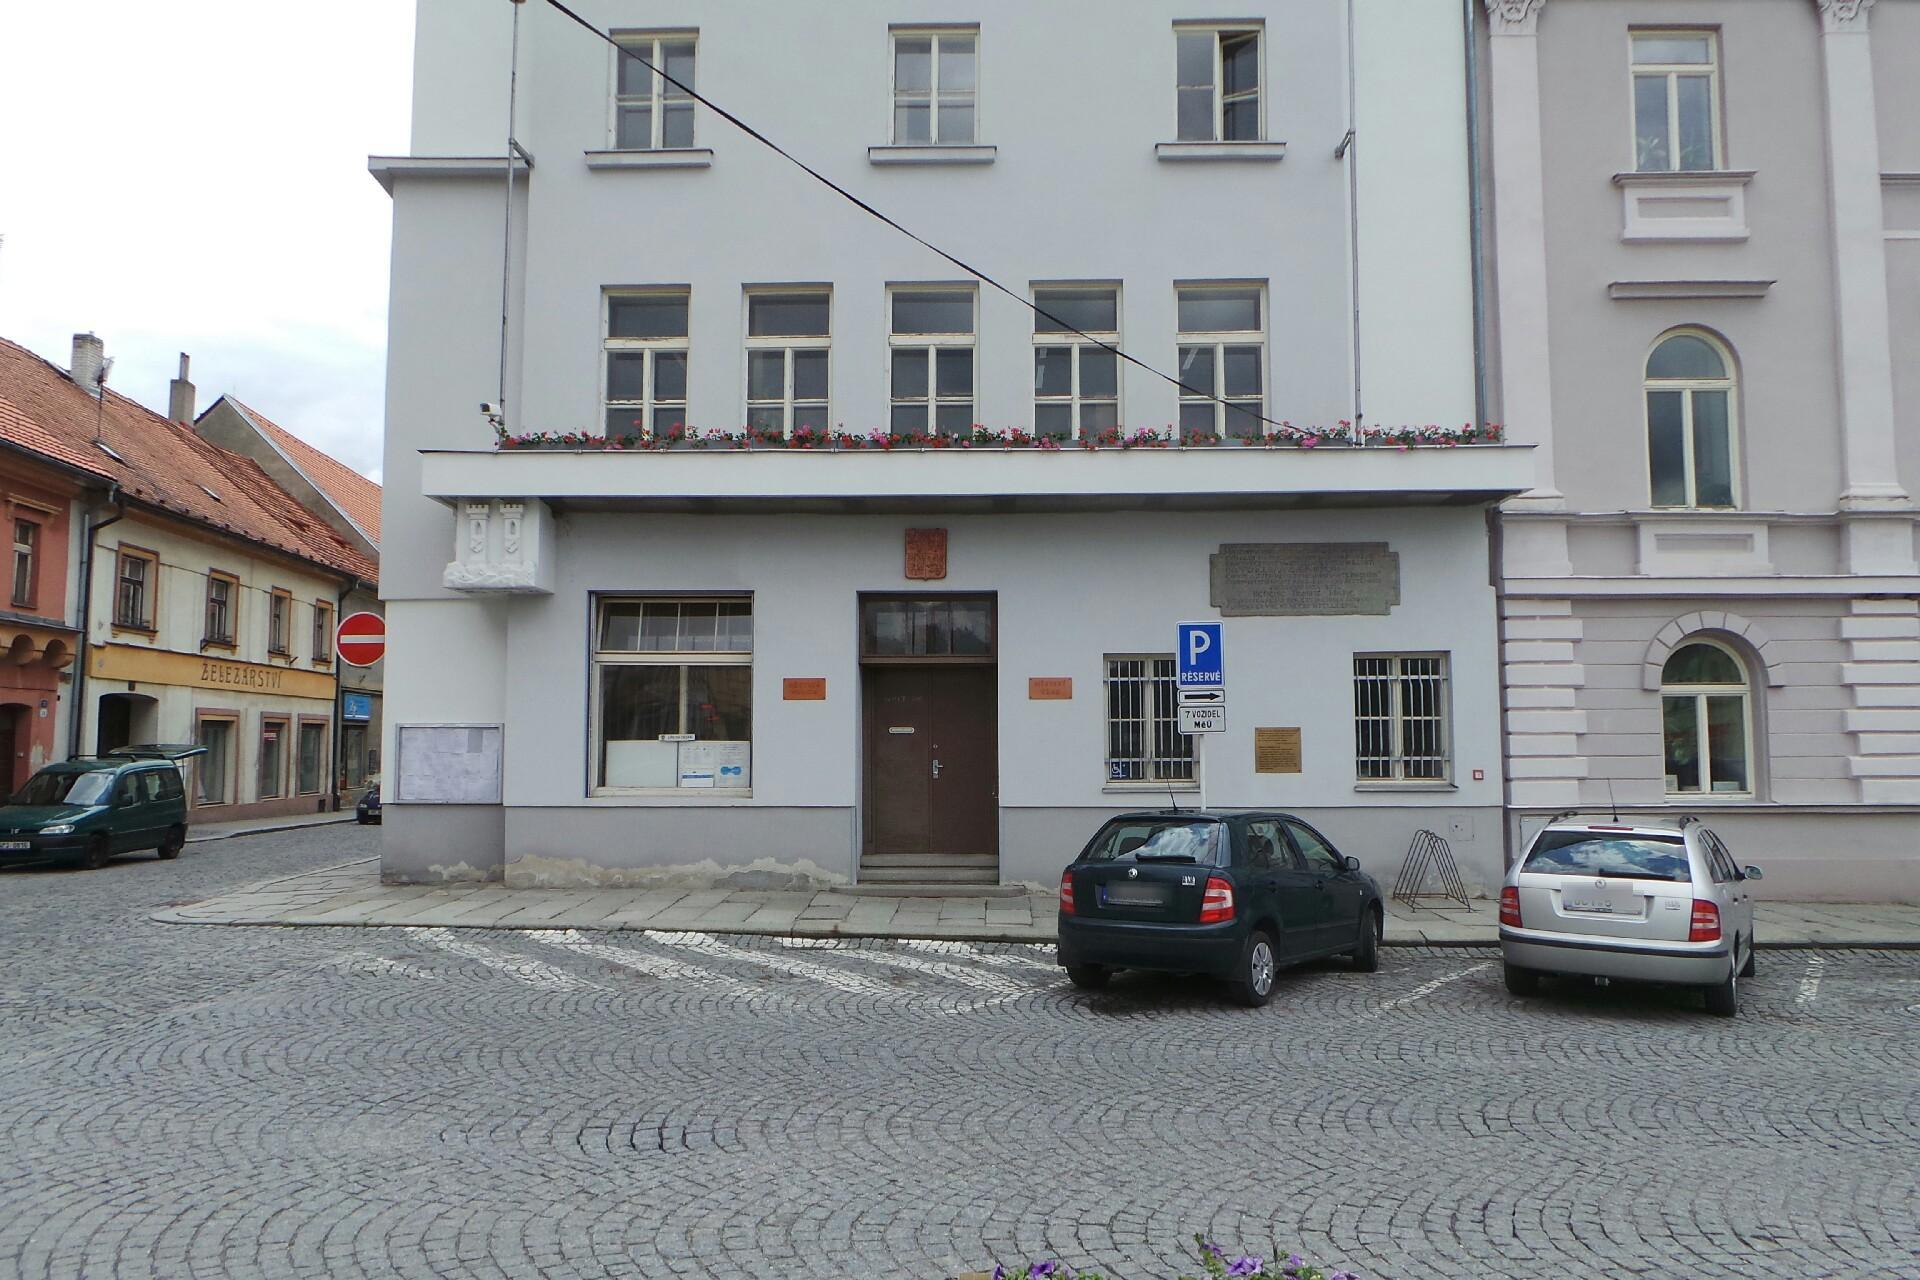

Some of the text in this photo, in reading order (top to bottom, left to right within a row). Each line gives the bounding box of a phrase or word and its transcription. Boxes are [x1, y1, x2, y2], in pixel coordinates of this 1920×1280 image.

[1189, 630, 1211, 665] P
[1181, 669, 1221, 681] RÉSERVÉ
[1185, 709, 1221, 719] 7 VOZIDEL
